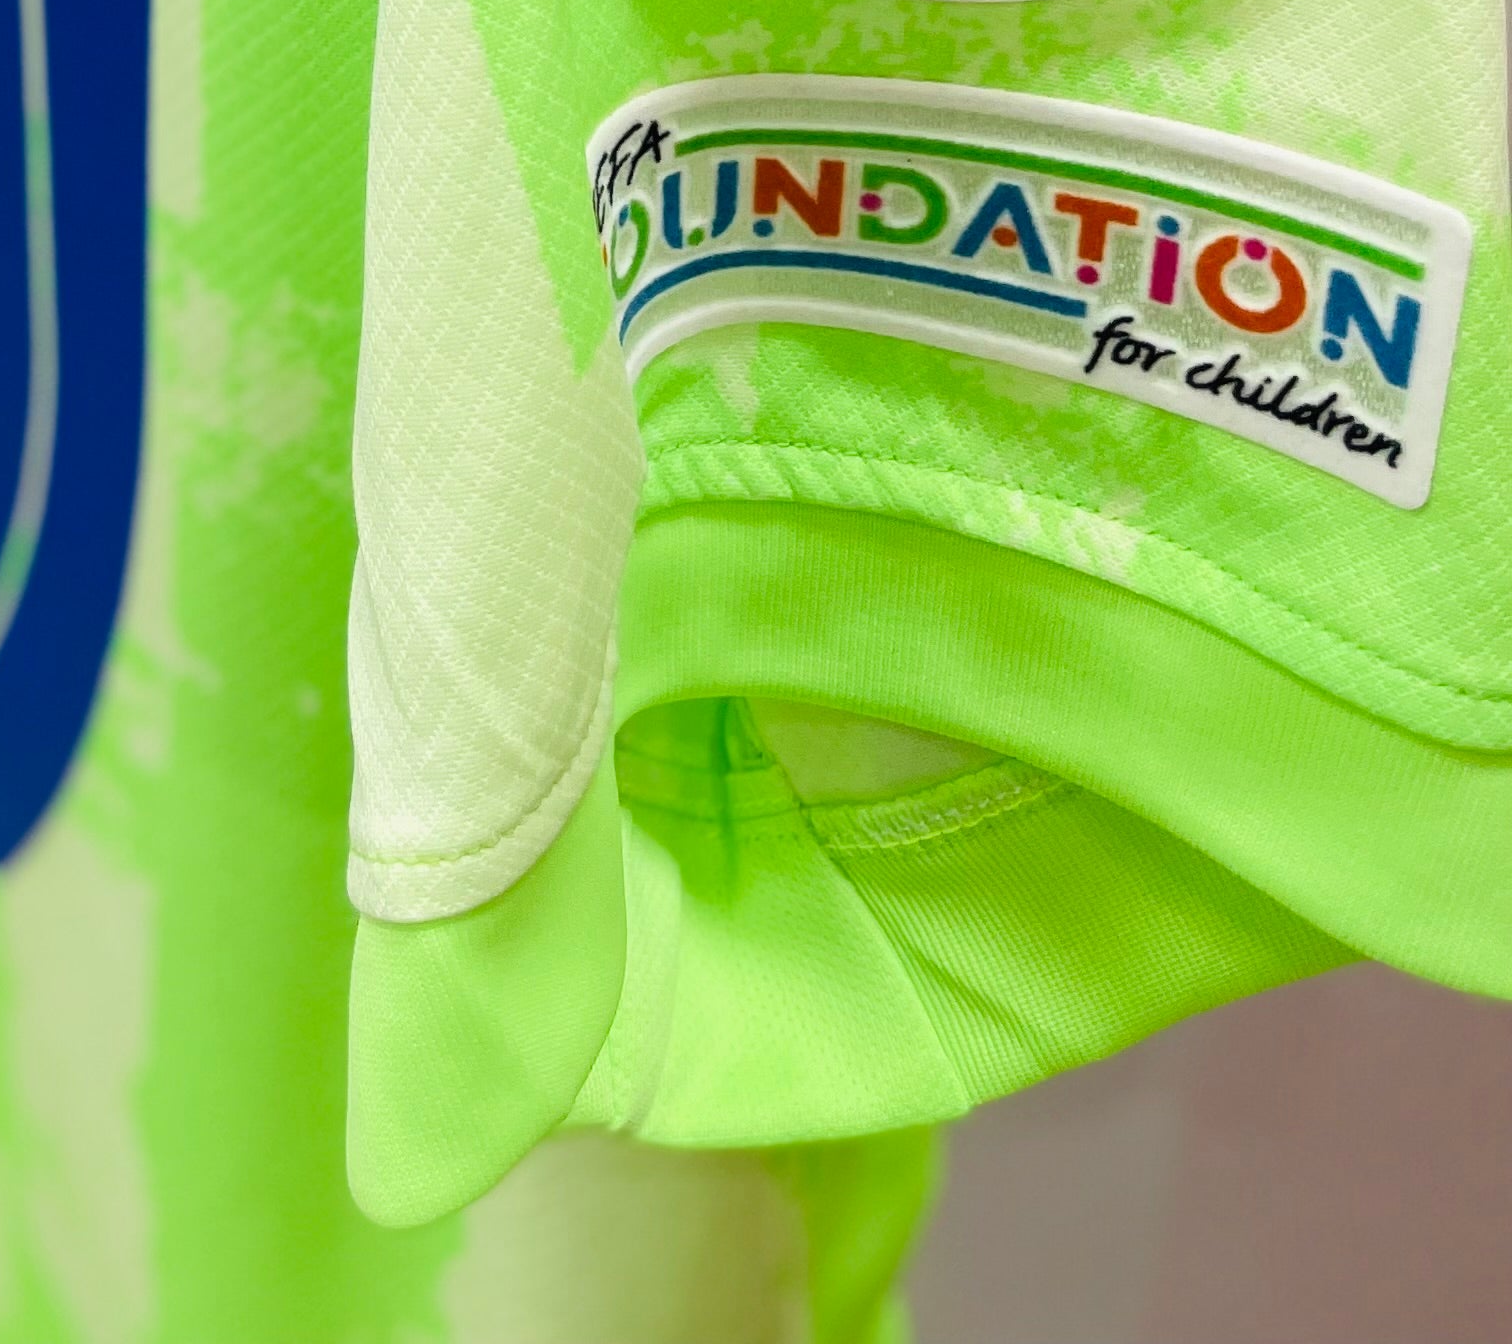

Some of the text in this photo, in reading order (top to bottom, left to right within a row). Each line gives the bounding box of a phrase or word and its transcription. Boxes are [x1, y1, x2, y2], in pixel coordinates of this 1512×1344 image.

[592, 119, 672, 235] EFA
[601, 156, 1422, 390] OUNDATION
[1083, 315, 1403, 469] for children
